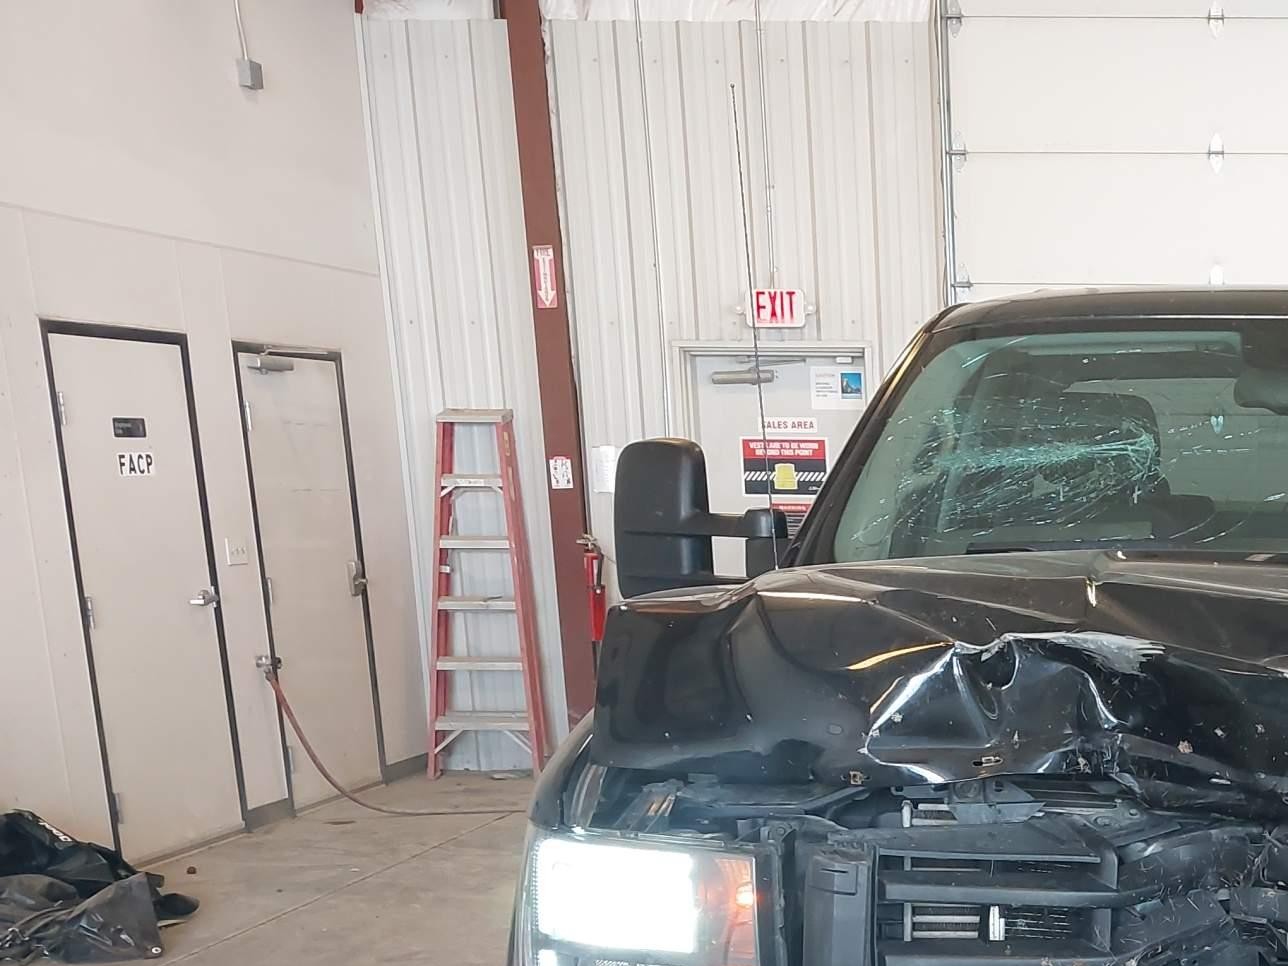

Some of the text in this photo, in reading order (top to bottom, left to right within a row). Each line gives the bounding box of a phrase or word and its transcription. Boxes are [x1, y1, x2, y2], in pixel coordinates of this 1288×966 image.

[755, 291, 796, 322] EXIT
[791, 420, 815, 430] AREA
[118, 453, 153, 475] FACP
